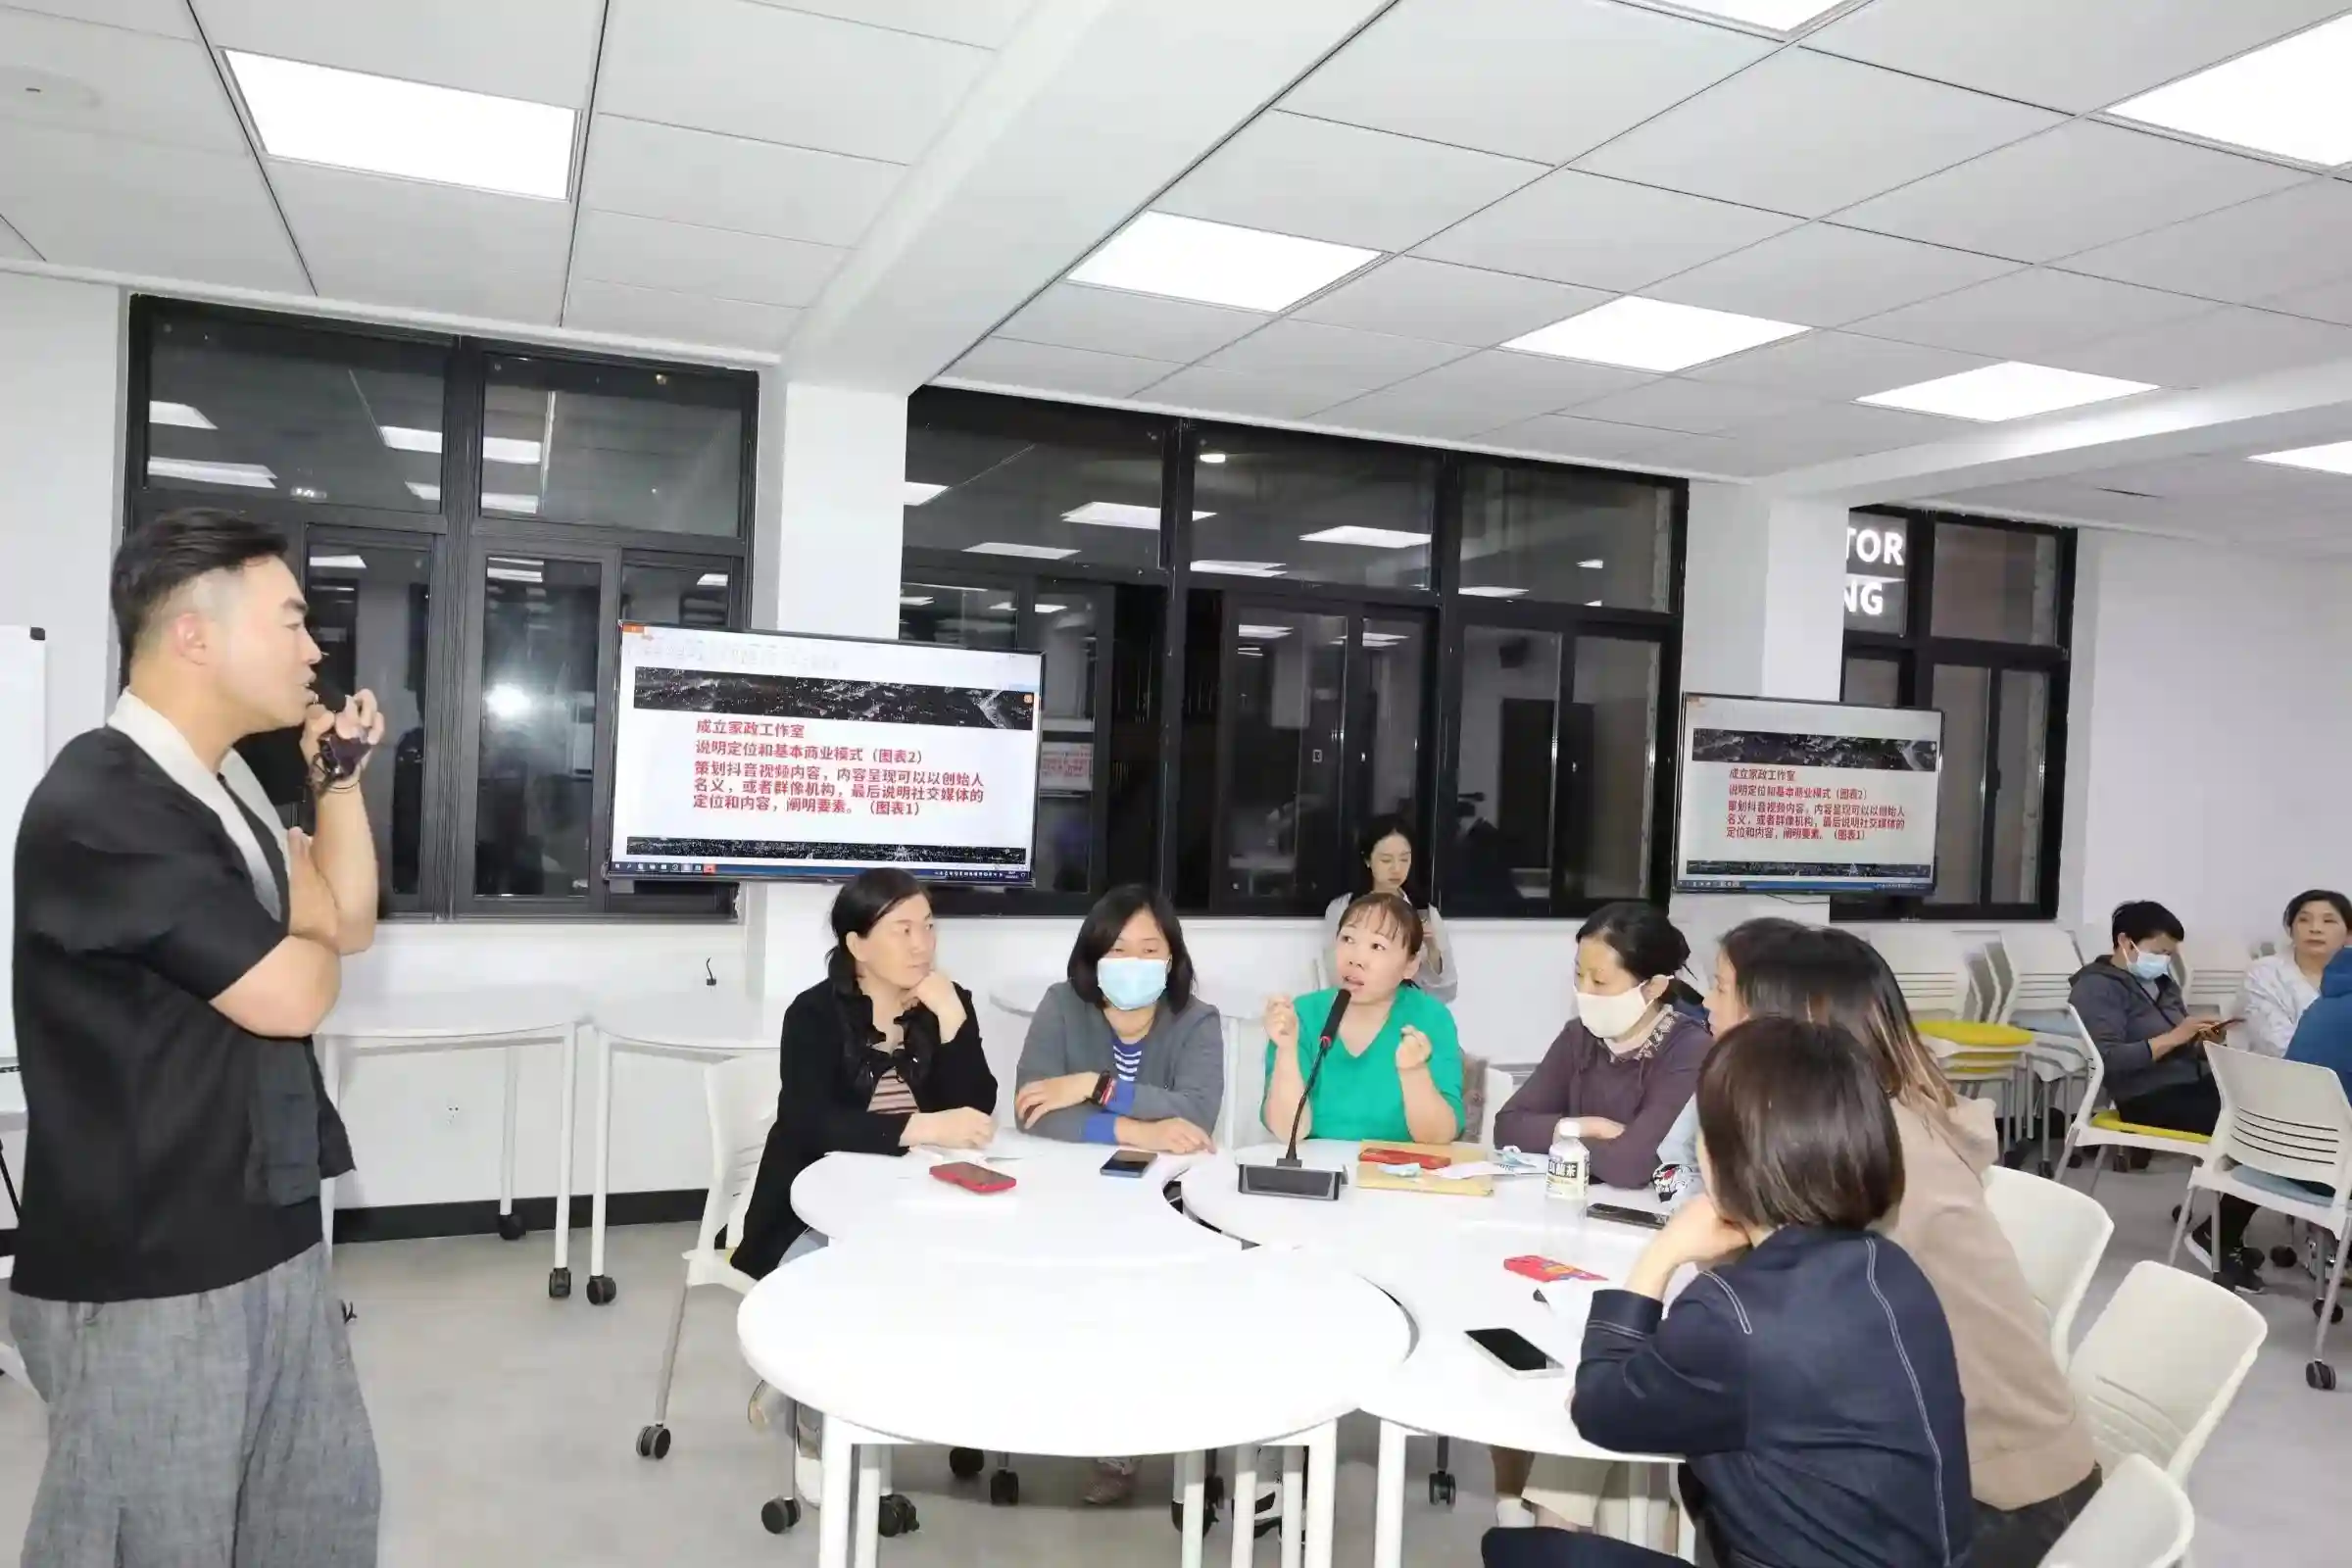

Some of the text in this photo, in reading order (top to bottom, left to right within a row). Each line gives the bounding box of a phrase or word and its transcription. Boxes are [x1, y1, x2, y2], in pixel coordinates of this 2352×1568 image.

[696, 719, 805, 739] 成立家政工作室
[694, 760, 984, 787] 策划抖音视频内容，内容呈现可以以创始人
[693, 777, 984, 803] 名义，或者群像机构，最后说明社交媒体的
